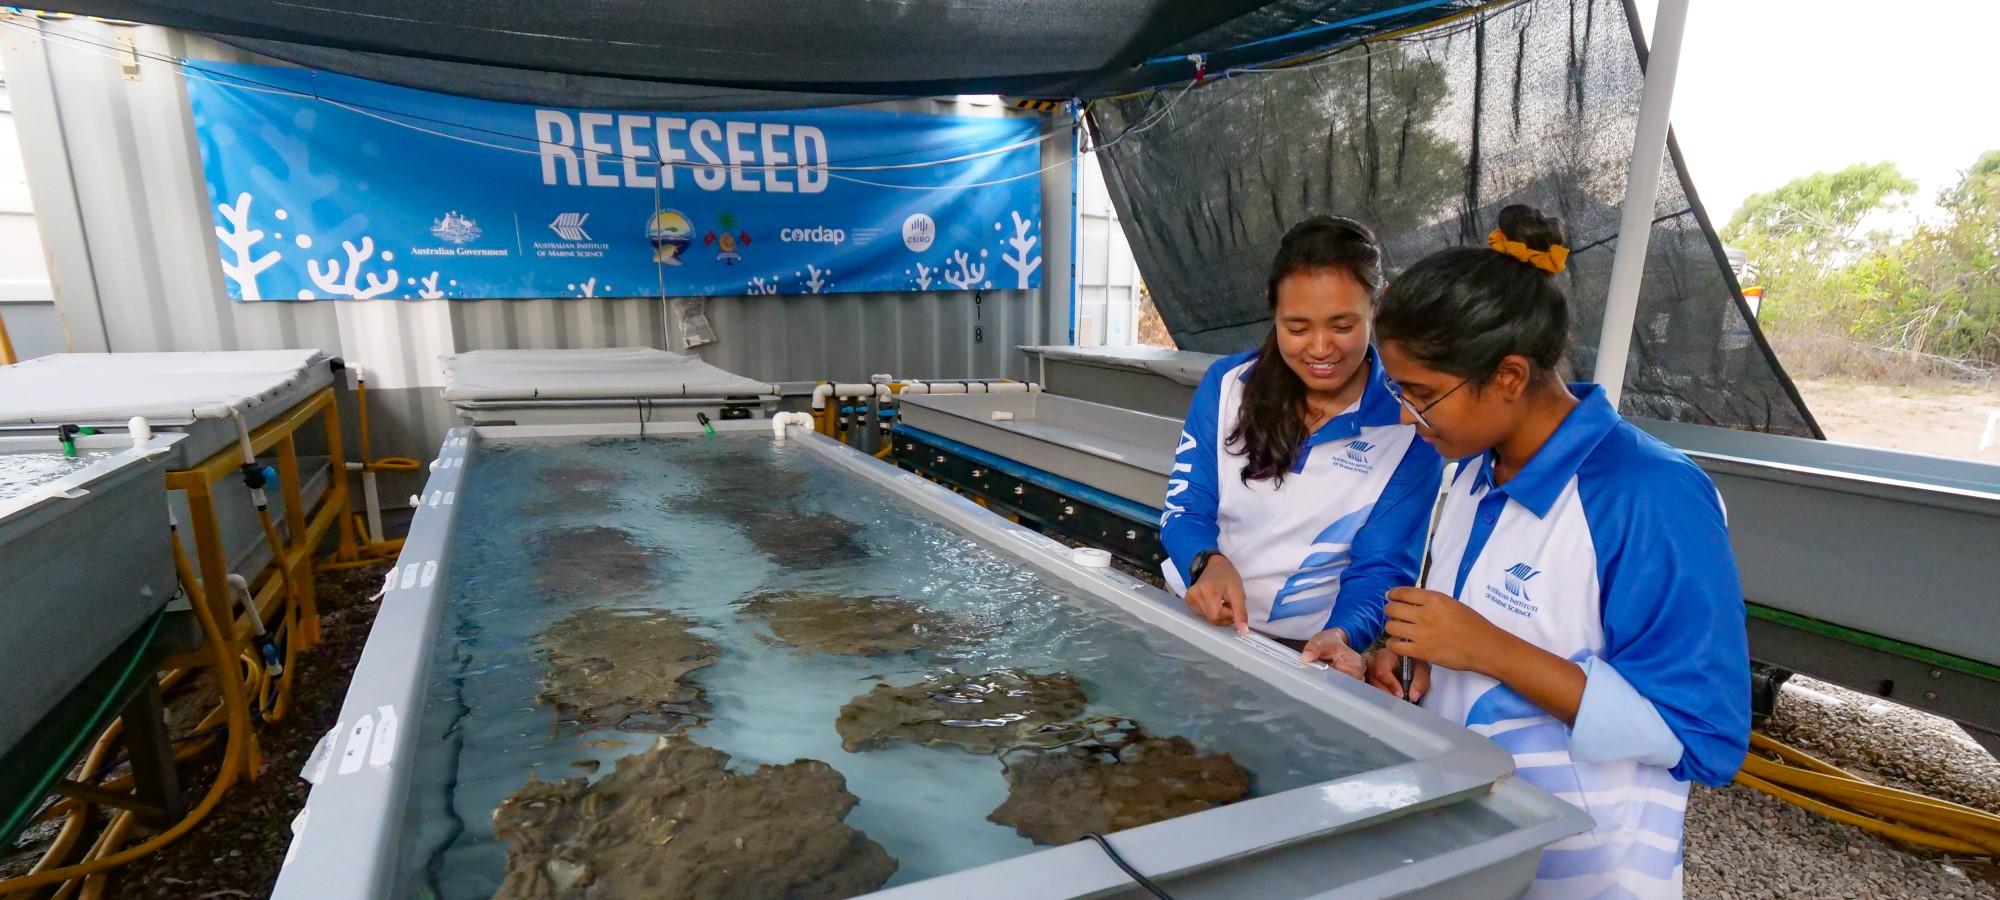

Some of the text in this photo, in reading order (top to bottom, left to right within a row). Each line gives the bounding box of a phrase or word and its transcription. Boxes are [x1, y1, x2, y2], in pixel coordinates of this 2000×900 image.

[535, 109, 828, 193] REEFSEED
[780, 225, 845, 245] cordap
[907, 236, 931, 244] CSIRO
[411, 247, 508, 257] Australian Government
[577, 242, 609, 250] INSTITUTE
[1508, 604, 1532, 618] SCIENCE
[1509, 597, 1539, 612] INSTITUTE
